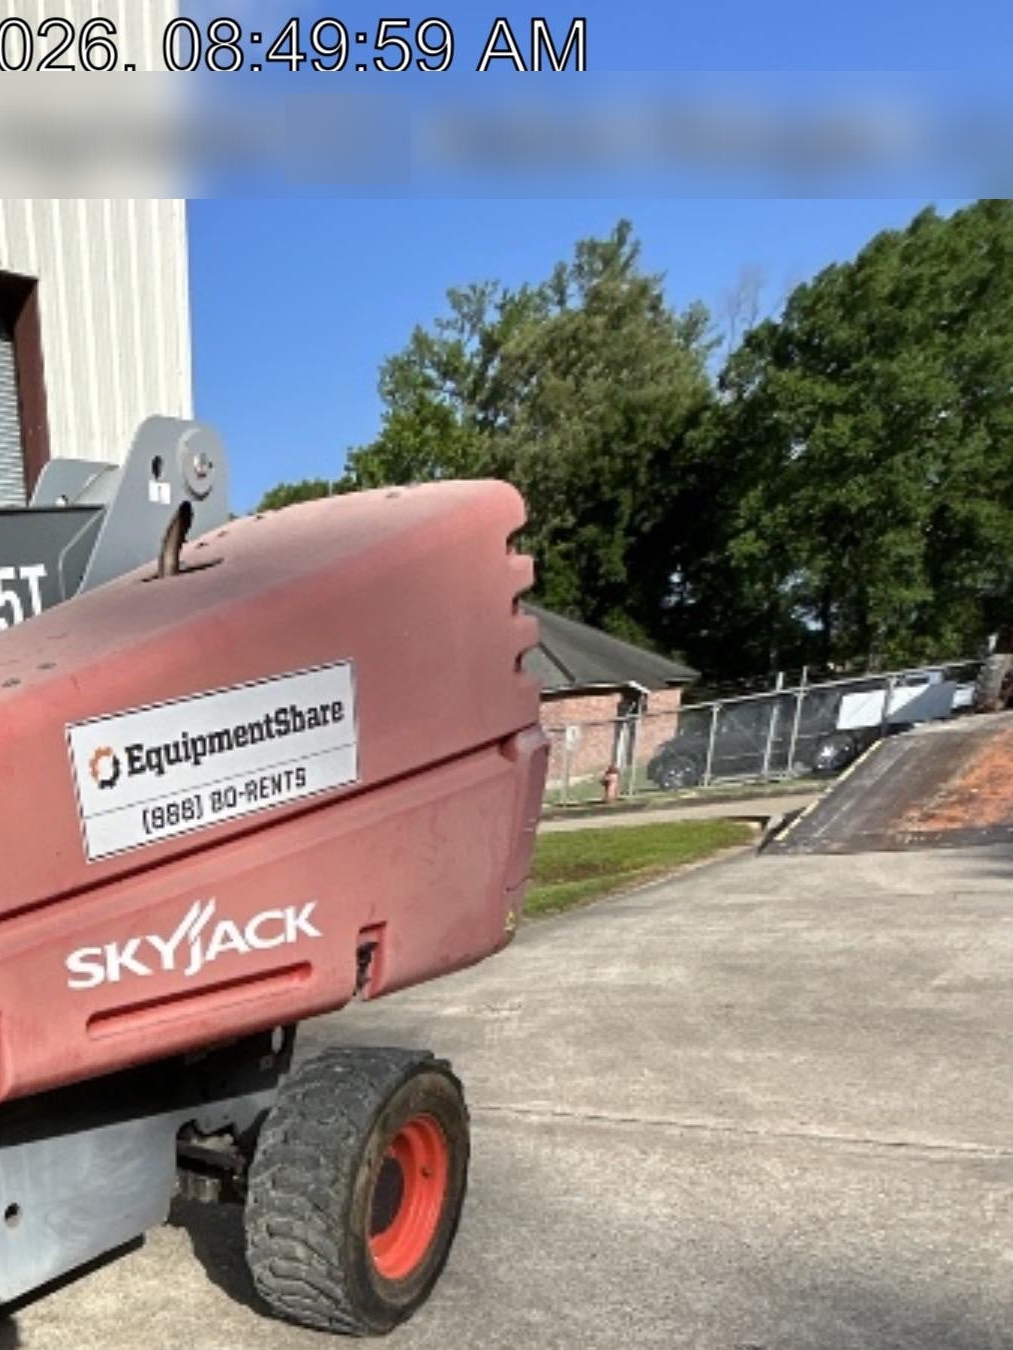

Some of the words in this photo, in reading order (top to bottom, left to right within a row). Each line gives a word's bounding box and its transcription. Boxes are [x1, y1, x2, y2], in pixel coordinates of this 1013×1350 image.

[124, 700, 345, 779] EquipmentShare
[142, 795, 202, 834] (888)
[65, 897, 323, 988] SKYJACK
